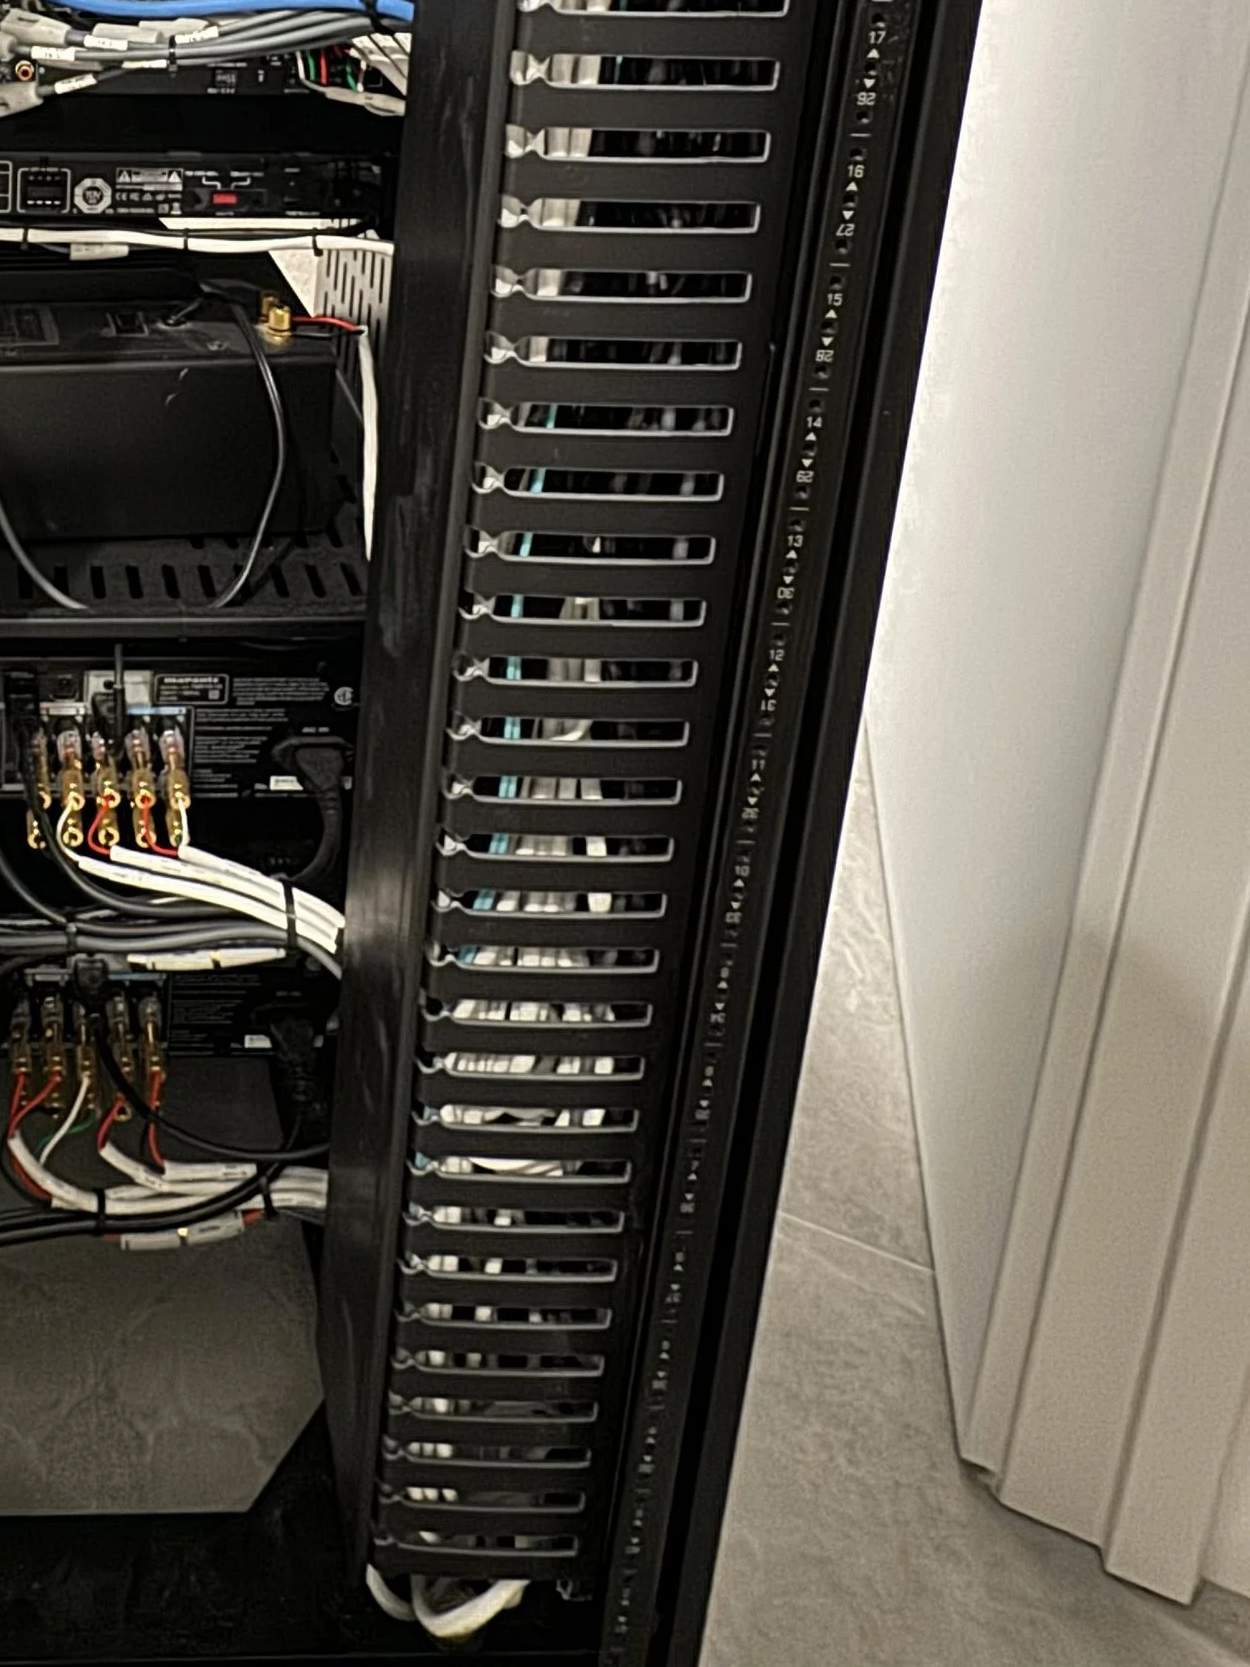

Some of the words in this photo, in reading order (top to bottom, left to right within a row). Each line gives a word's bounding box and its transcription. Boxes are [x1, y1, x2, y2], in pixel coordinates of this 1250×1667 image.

[868, 31, 886, 44] 17
[847, 164, 864, 178] 16
[826, 293, 843, 306] 15
[806, 416, 822, 428] 14
[787, 535, 803, 547] 13
